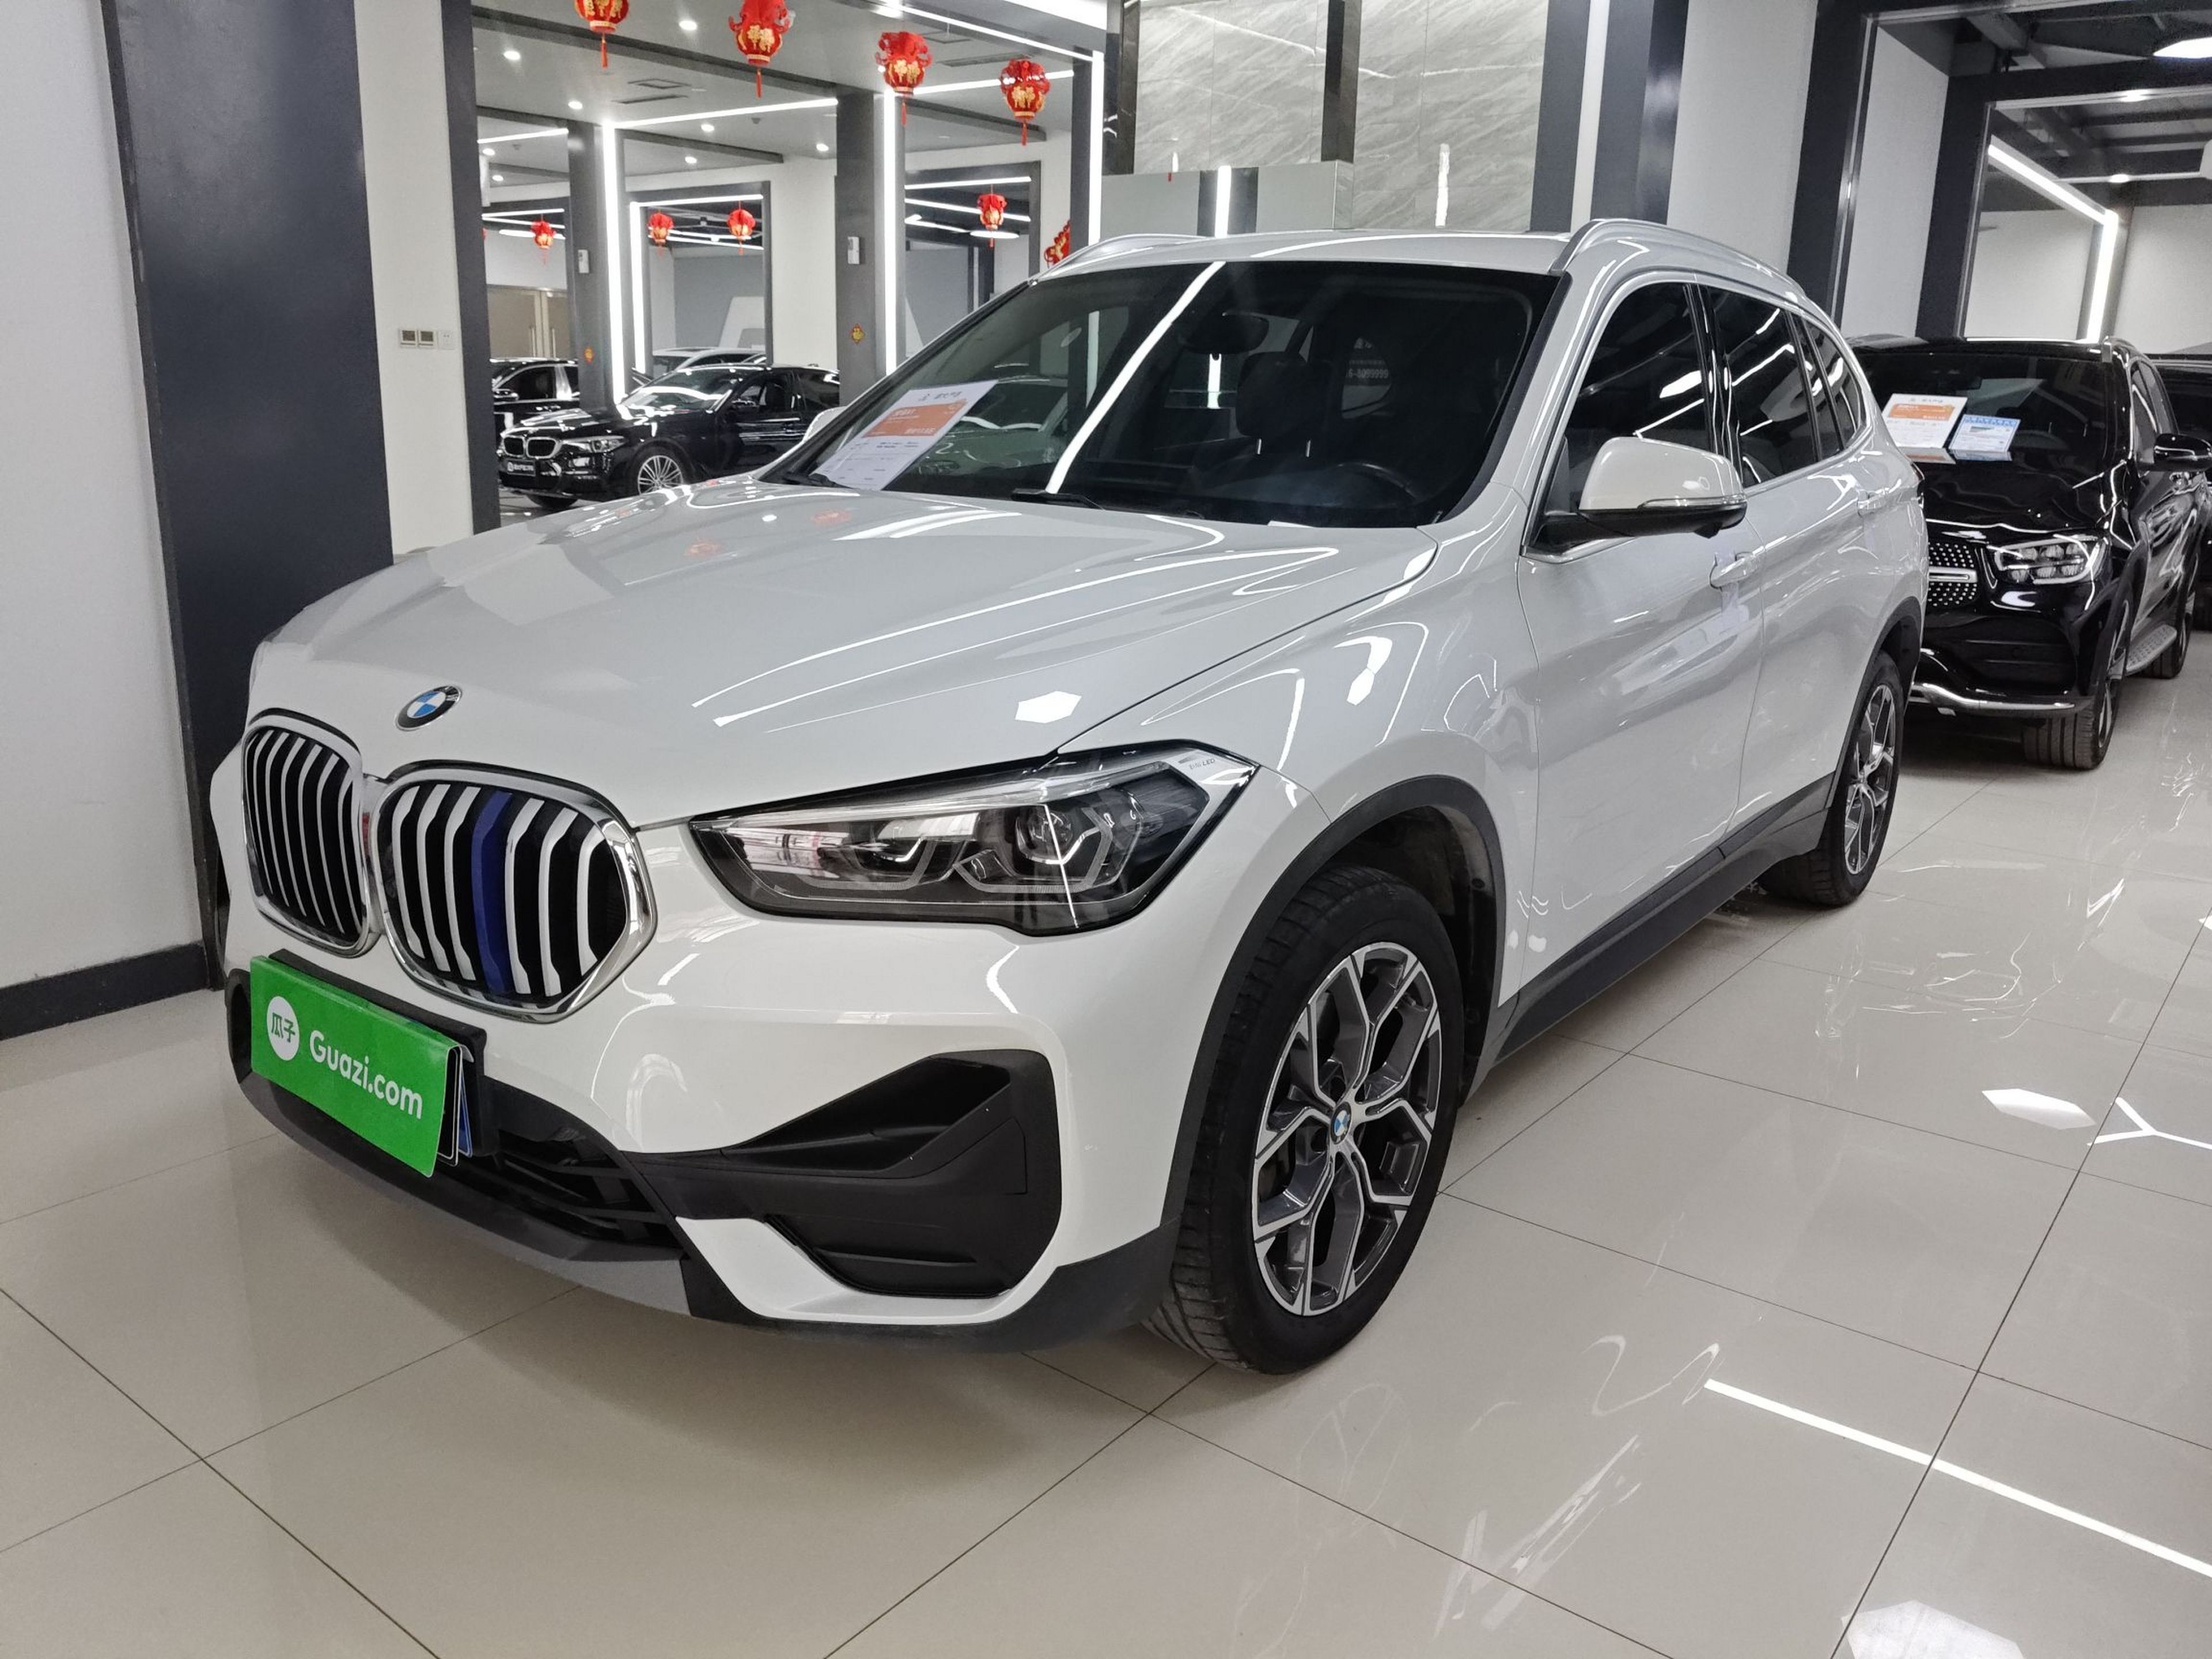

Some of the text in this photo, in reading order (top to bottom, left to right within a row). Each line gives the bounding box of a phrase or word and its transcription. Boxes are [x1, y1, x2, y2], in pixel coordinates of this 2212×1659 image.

[1202, 758, 1215, 766] LED
[271, 1012, 296, 1043] 瓜子
[309, 1029, 423, 1120] Guazi.com
